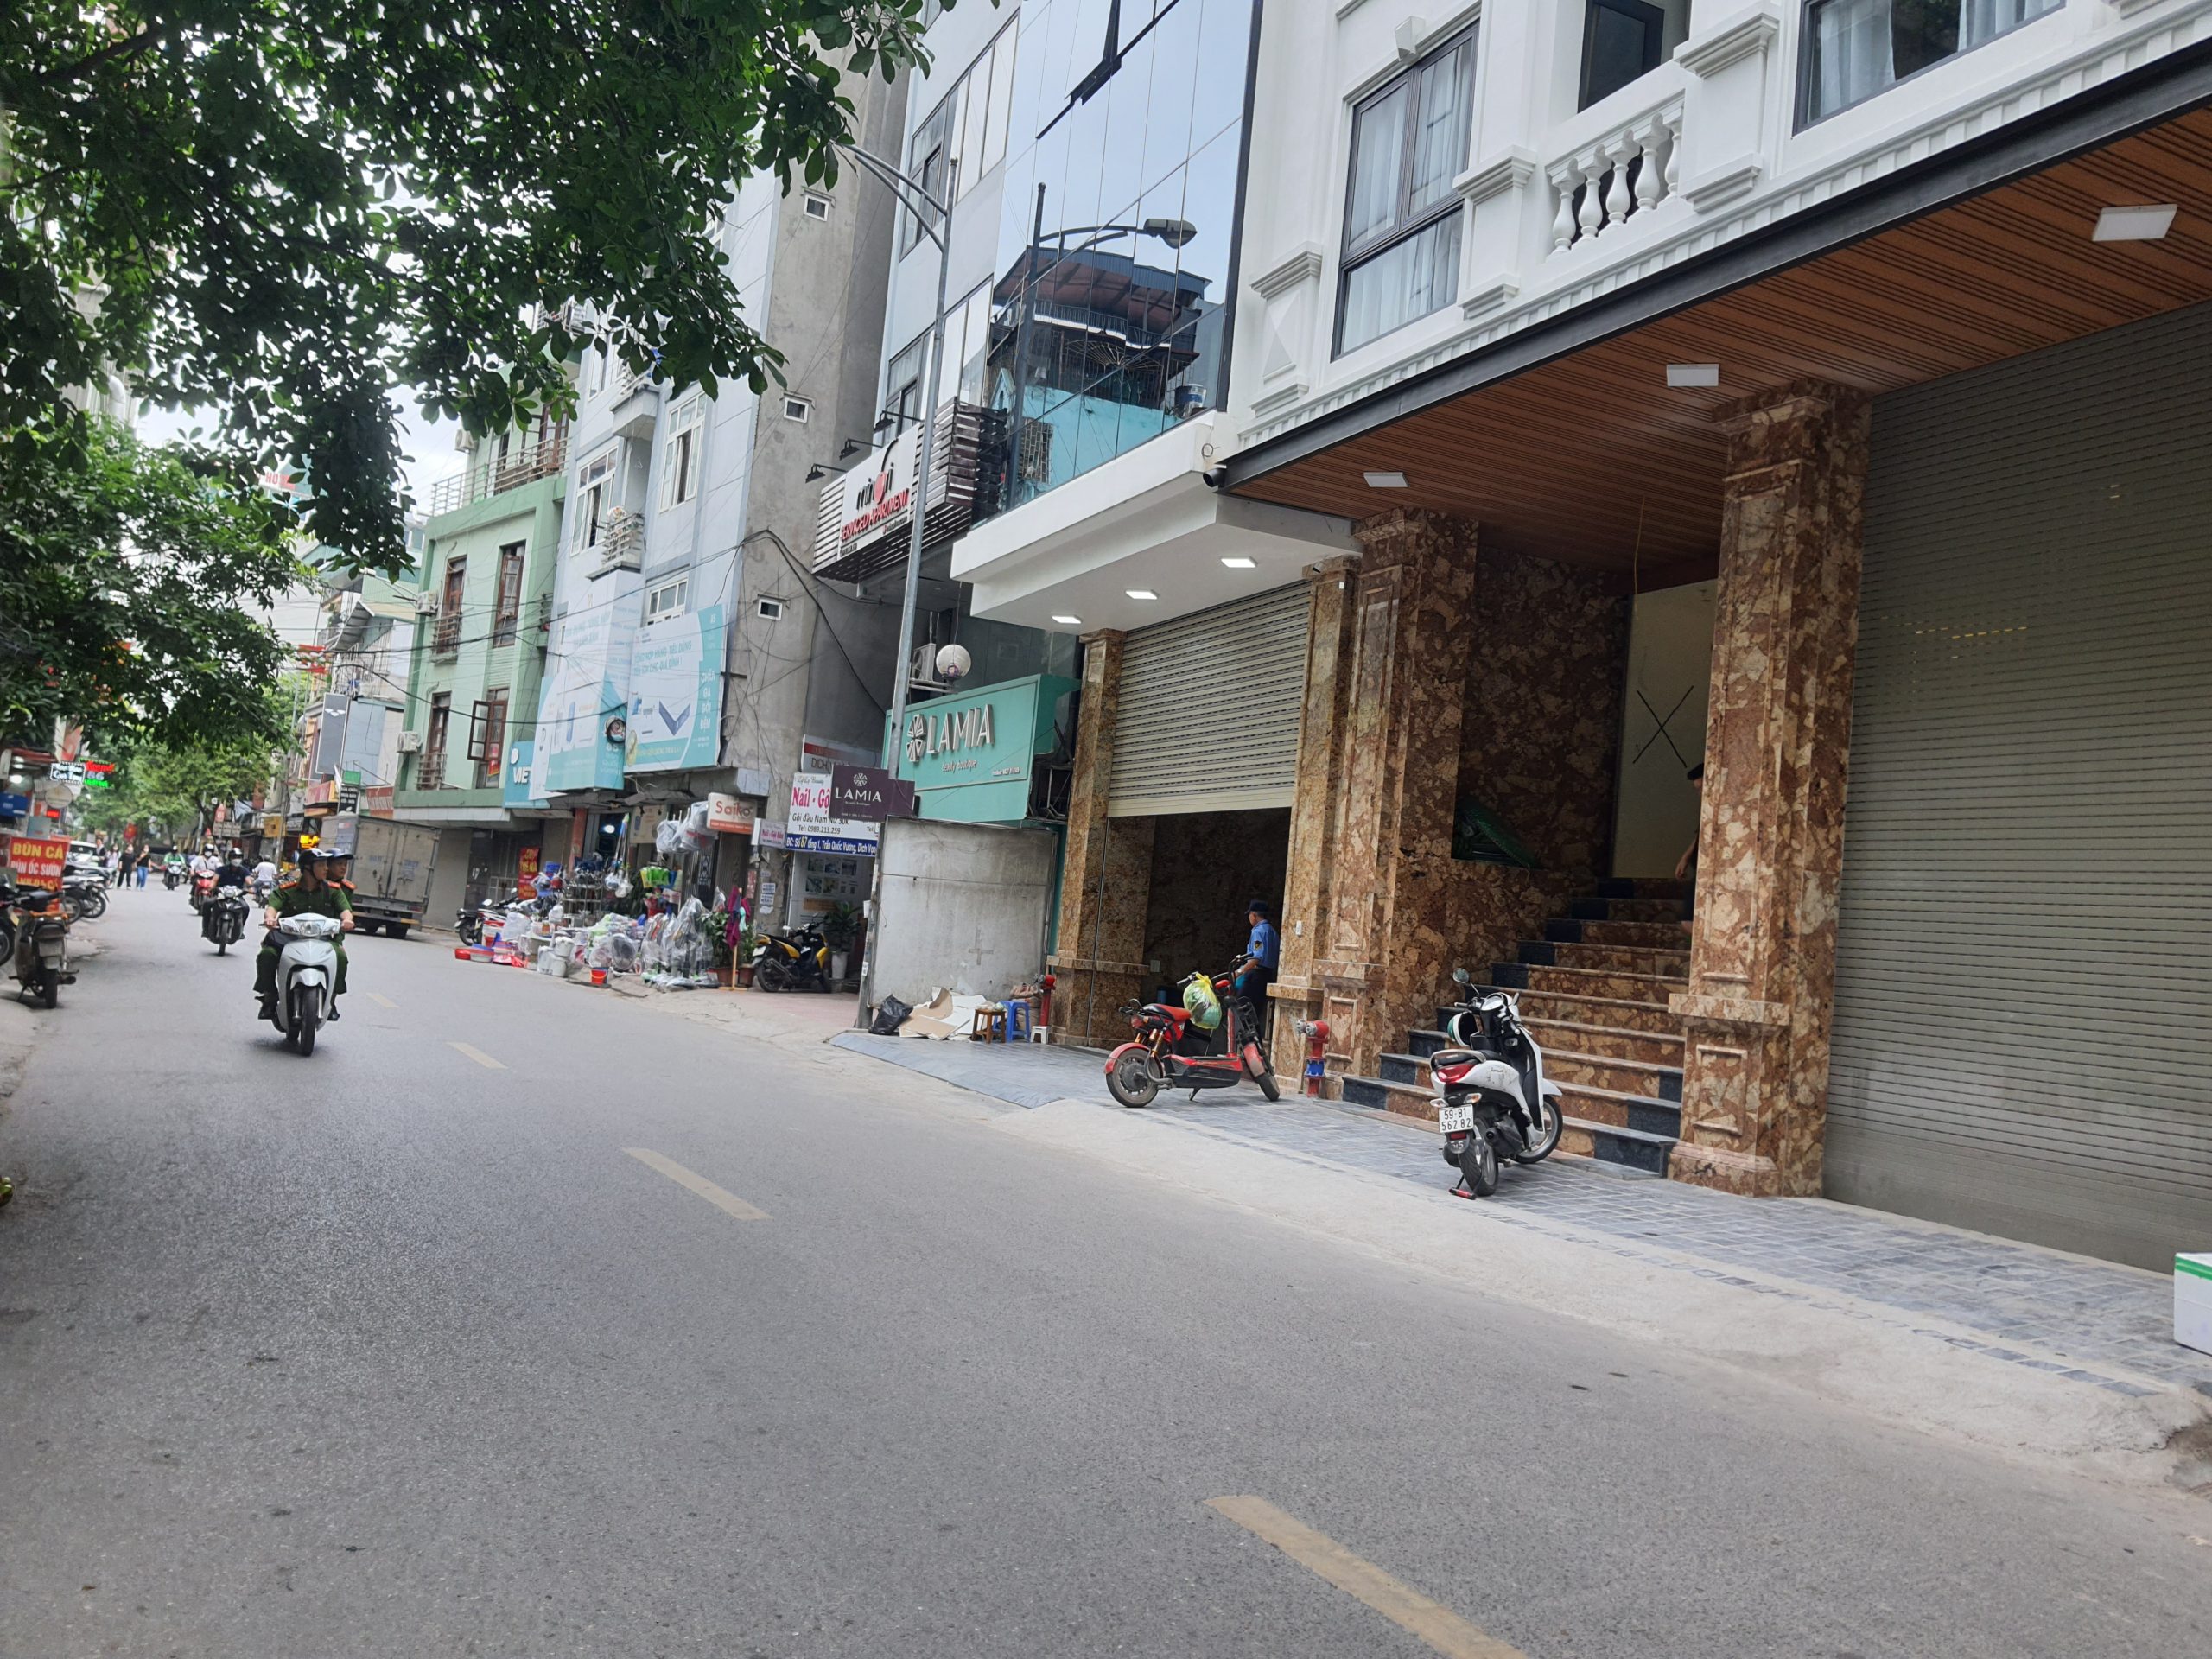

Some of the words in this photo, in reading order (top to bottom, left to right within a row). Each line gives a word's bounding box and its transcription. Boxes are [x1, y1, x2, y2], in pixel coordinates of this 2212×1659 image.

[926, 704, 994, 755] LAMIA
[792, 787, 810, 807] Nail
[835, 787, 881, 802] LAMIA
[715, 800, 752, 817] Saiko
[792, 813, 802, 823] Gội
[815, 815, 827, 823] Nam
[801, 836, 808, 848] 87
